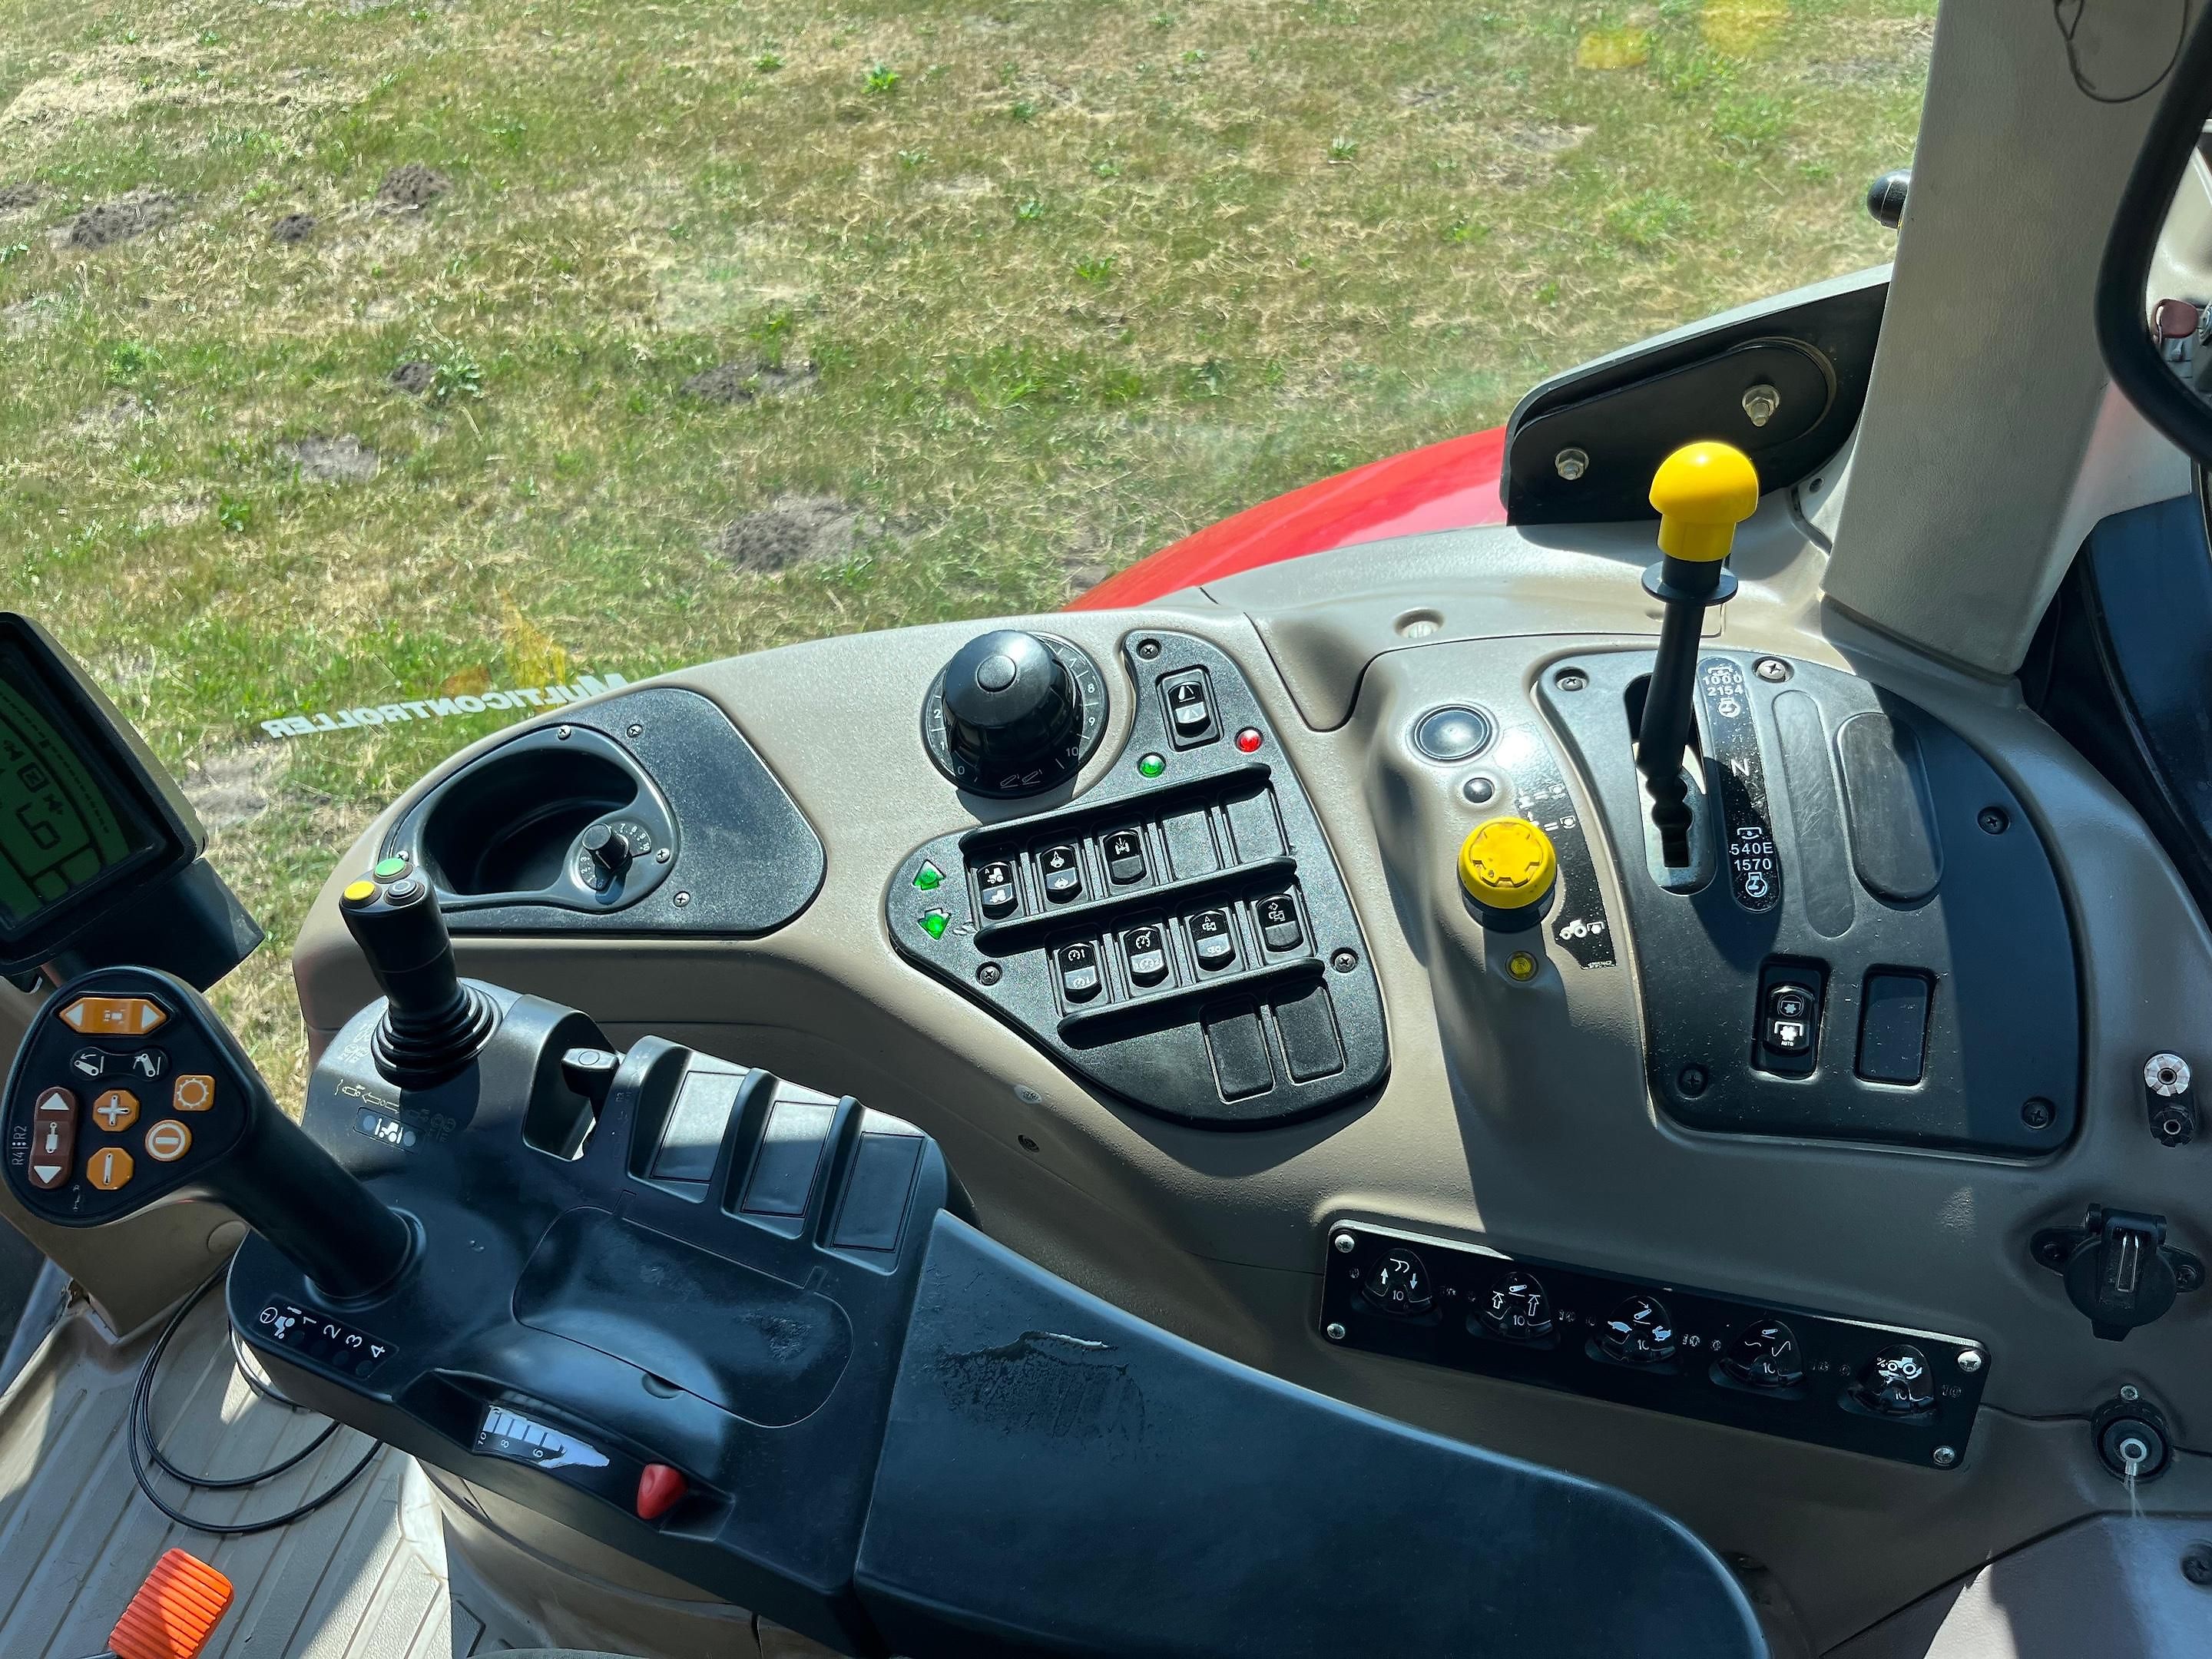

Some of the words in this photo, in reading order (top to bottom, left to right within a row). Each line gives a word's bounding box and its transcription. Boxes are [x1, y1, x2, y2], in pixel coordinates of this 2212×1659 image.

[1703, 674, 1743, 685] 1000
[1087, 683, 1096, 694] 8
[1707, 685, 1744, 697] 2154
[933, 709, 942, 719] 2
[1088, 717, 1096, 727] 9
[939, 741, 945, 751] 1
[1066, 747, 1080, 758] 10
[958, 765, 965, 776] 0
[1730, 757, 1750, 777] N
[643, 842, 651, 851] 10
[1730, 842, 1773, 856] 540E
[1734, 858, 1772, 871] 1570
[1392, 1289, 1405, 1302] 10
[303, 1315, 317, 1324] 1
[1513, 1314, 1525, 1326] 10
[322, 1323, 342, 1339] 2
[345, 1333, 363, 1349] 3
[370, 1343, 386, 1359] 4
[478, 1432, 487, 1445] 10
[500, 1439, 510, 1449] 8
[532, 1448, 544, 1459] 6
